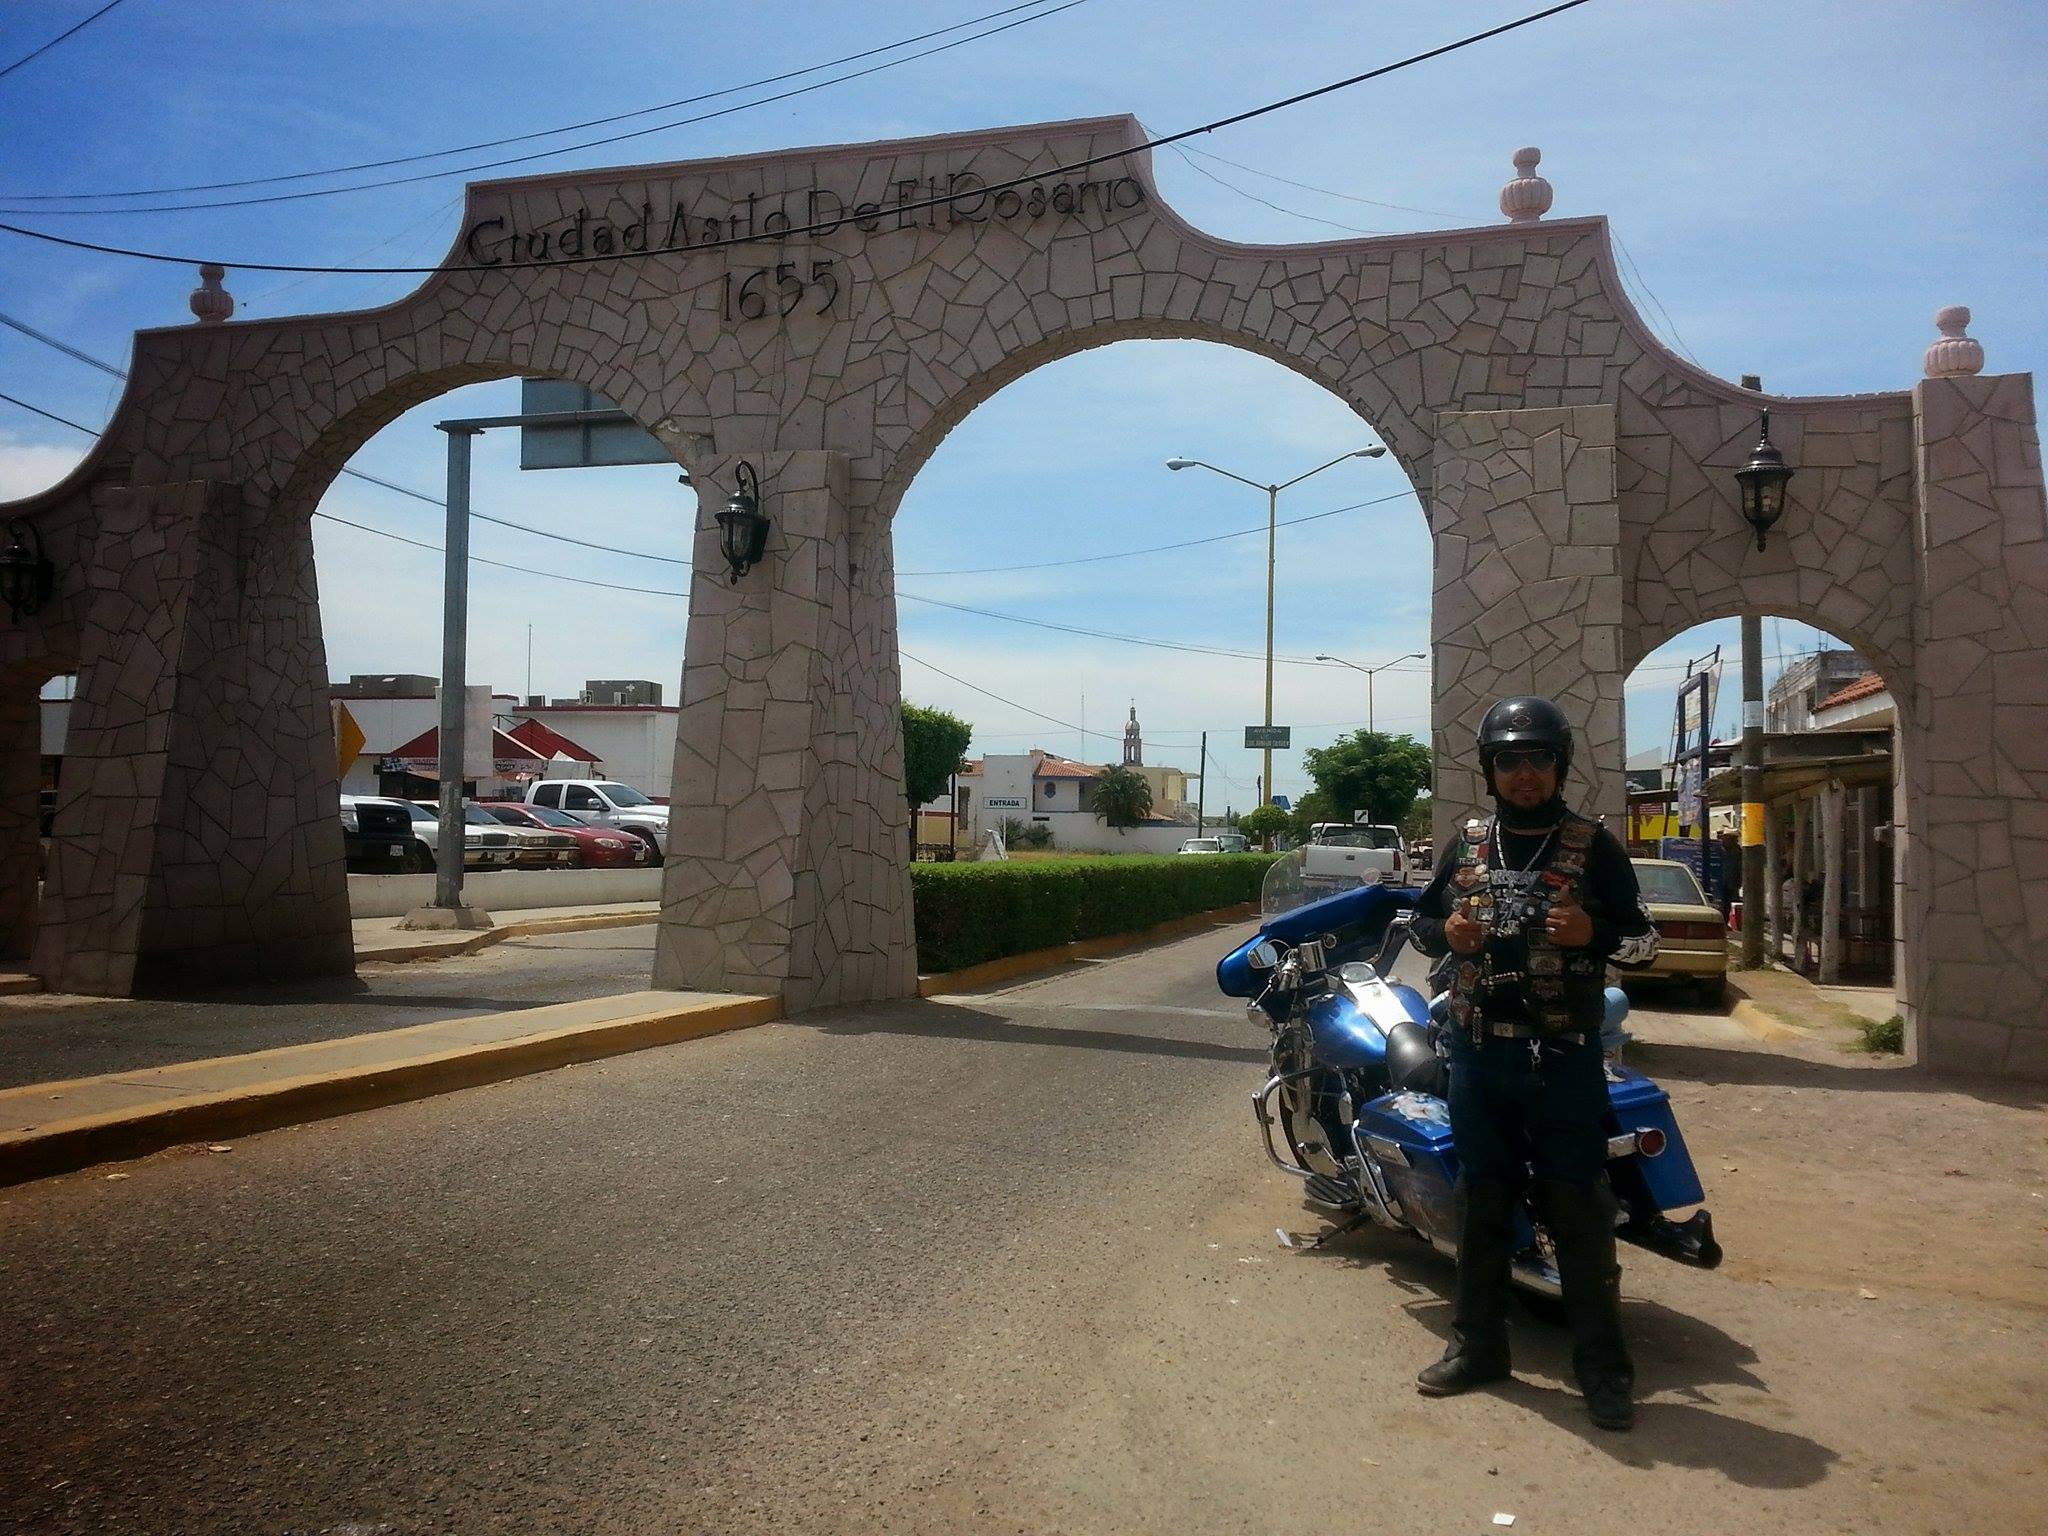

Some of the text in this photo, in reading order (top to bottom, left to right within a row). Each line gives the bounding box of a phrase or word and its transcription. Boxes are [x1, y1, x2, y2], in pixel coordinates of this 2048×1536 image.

[468, 201, 648, 265] Ciudad
[808, 190, 880, 238] De
[897, 176, 937, 229] El
[947, 171, 1143, 226] Rosario
[723, 259, 839, 321] 1655
[989, 799, 1020, 808] ENTRADA
